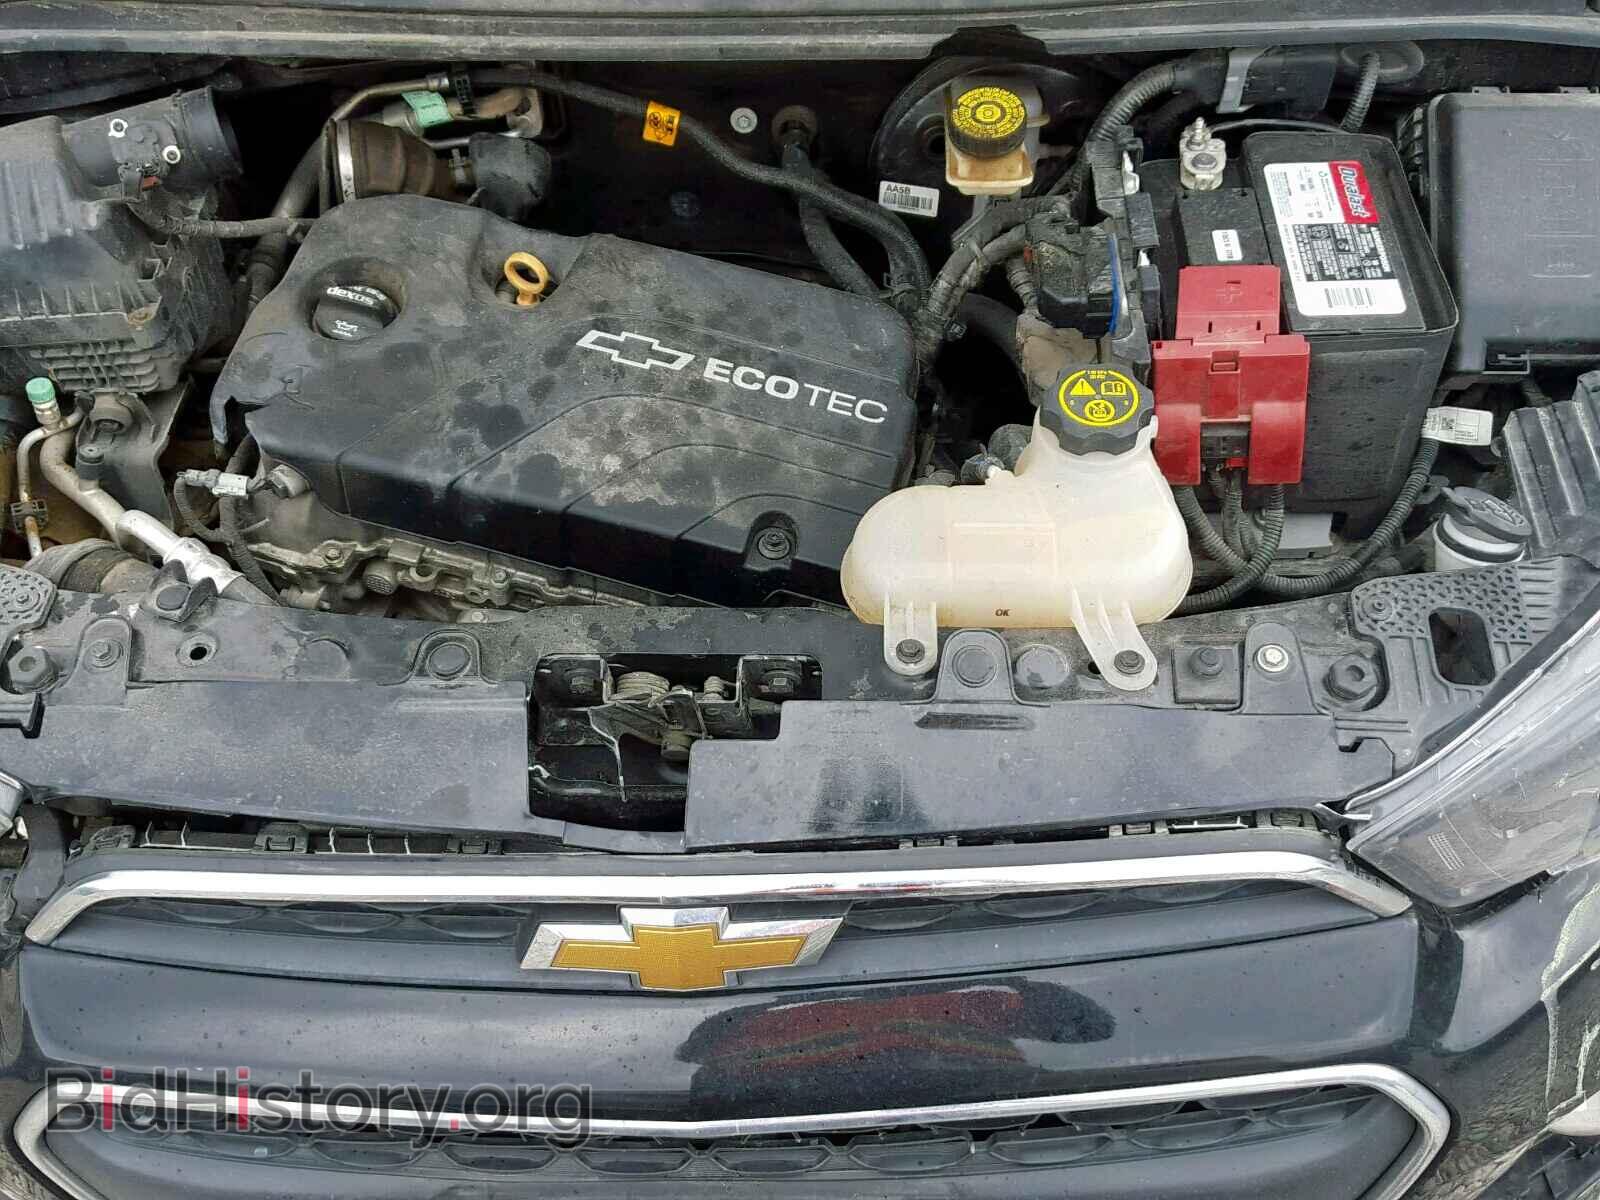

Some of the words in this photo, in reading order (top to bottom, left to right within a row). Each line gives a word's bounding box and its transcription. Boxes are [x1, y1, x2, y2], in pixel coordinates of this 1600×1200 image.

[1338, 166, 1370, 218] Duralast
[327, 287, 374, 305] dexos
[703, 357, 888, 424] ECOTEC
[995, 608, 1011, 616] OK
